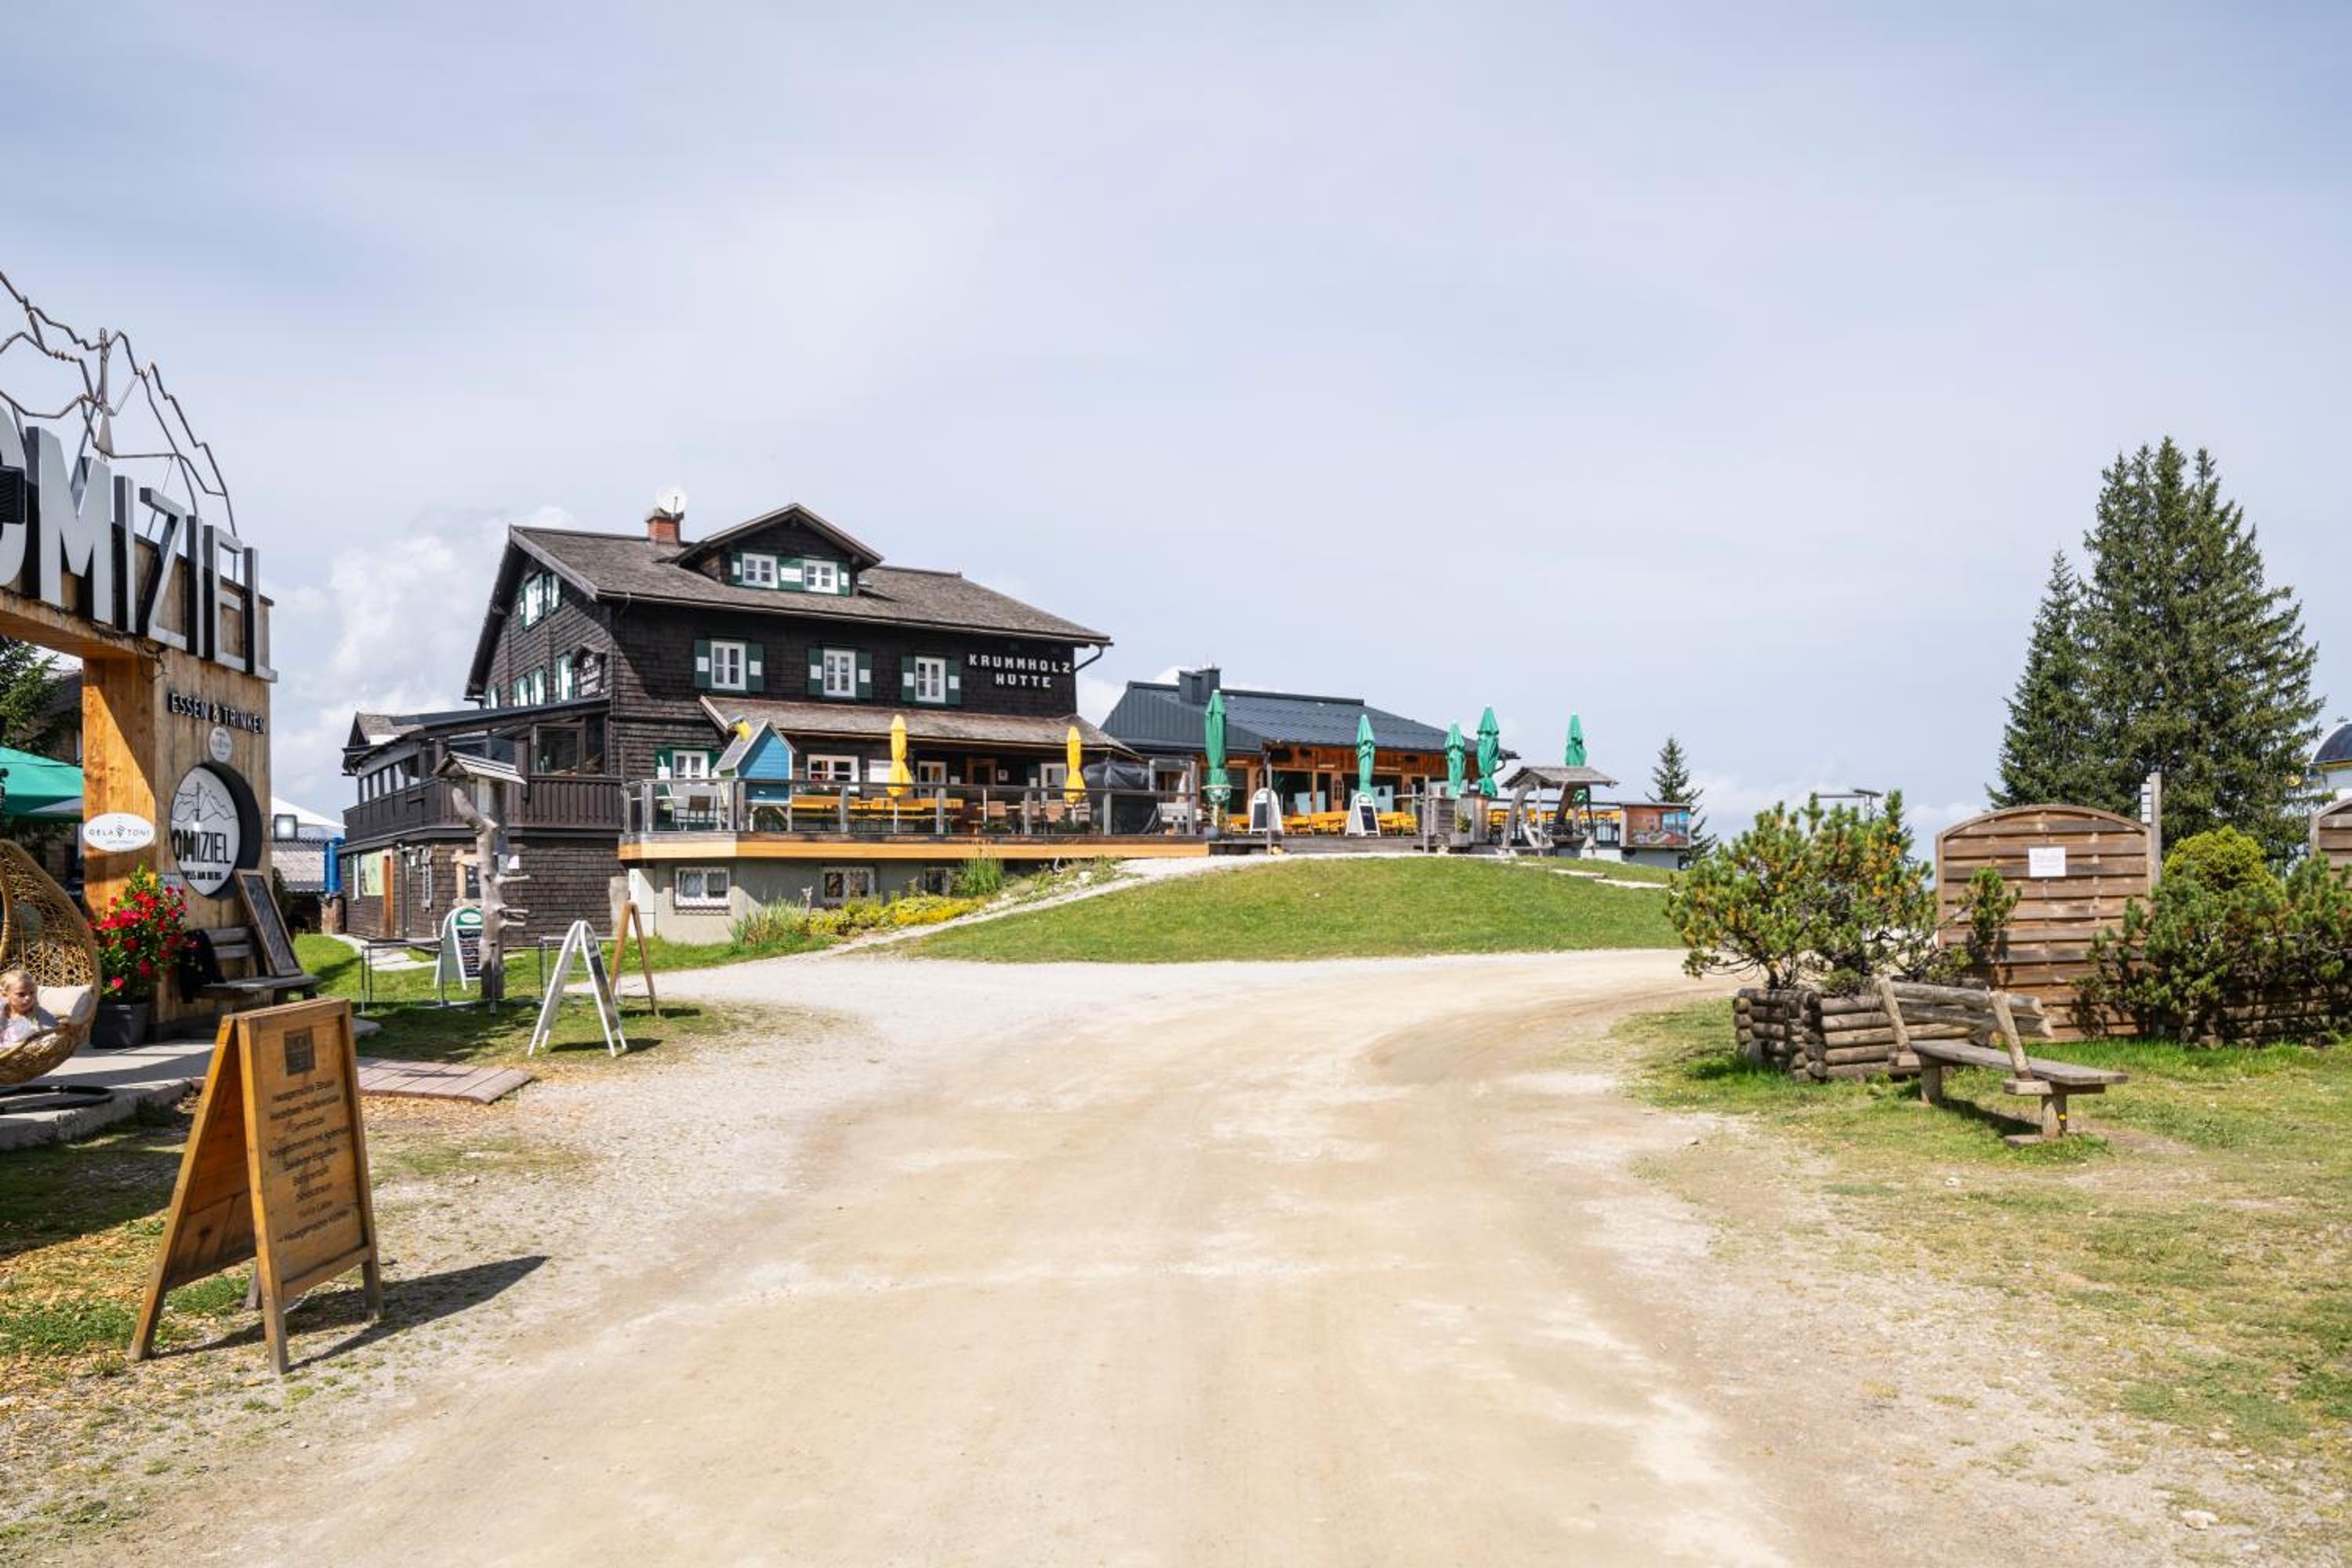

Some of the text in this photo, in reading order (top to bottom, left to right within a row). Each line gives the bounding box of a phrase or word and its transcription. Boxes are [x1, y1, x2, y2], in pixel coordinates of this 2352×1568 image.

[969, 654, 1070, 673] KRUMMHOLZ
[169, 692, 209, 720] ESSEN
[212, 703, 220, 722] &
